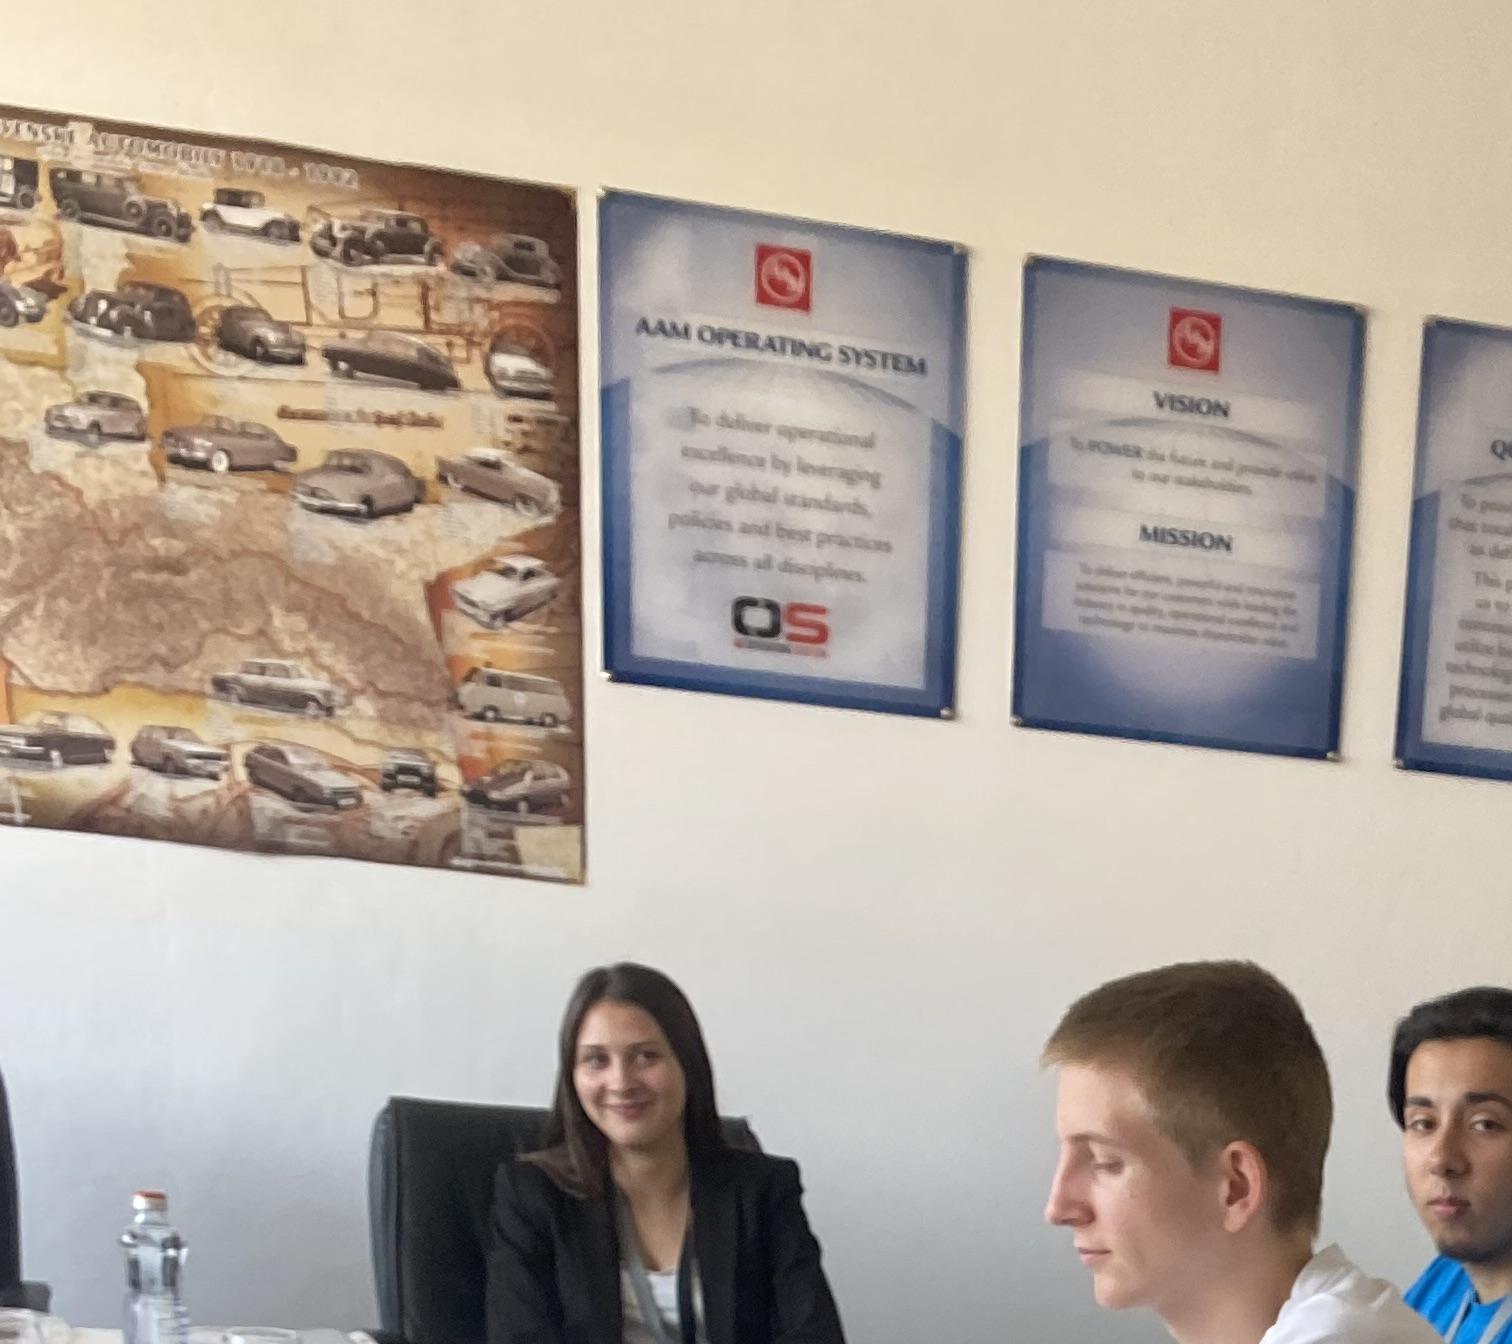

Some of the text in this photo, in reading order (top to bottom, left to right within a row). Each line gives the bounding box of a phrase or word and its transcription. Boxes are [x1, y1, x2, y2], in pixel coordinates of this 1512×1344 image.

[635, 316, 928, 376] AAM OPERATING SYSTEM
[1152, 389, 1231, 421] VISION
[1138, 523, 1233, 553] MISSION
